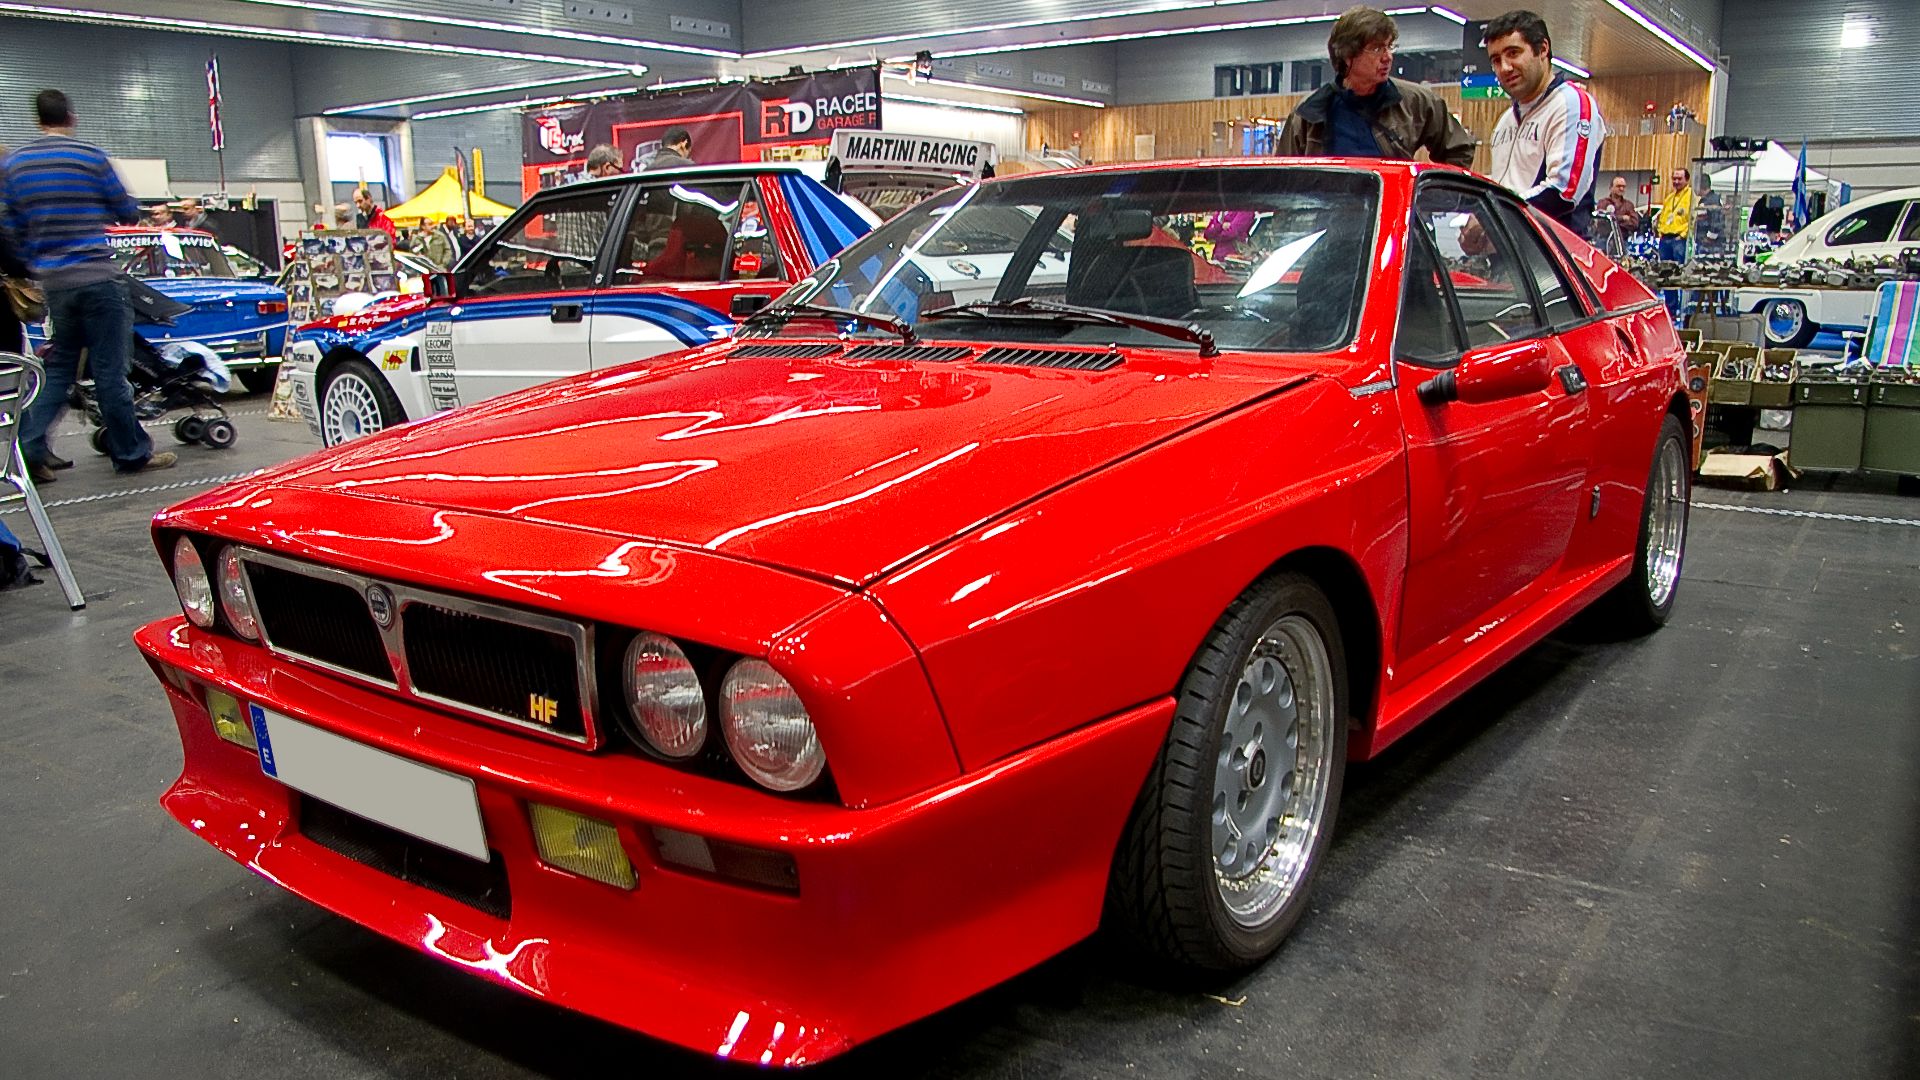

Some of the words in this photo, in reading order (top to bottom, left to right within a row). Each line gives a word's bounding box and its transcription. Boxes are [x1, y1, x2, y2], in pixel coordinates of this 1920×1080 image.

[817, 114, 864, 130] GARAGE
[845, 136, 916, 162] MARTINI
[918, 141, 978, 166] RACING
[530, 693, 558, 724] HF
[262, 747, 272, 765] E
